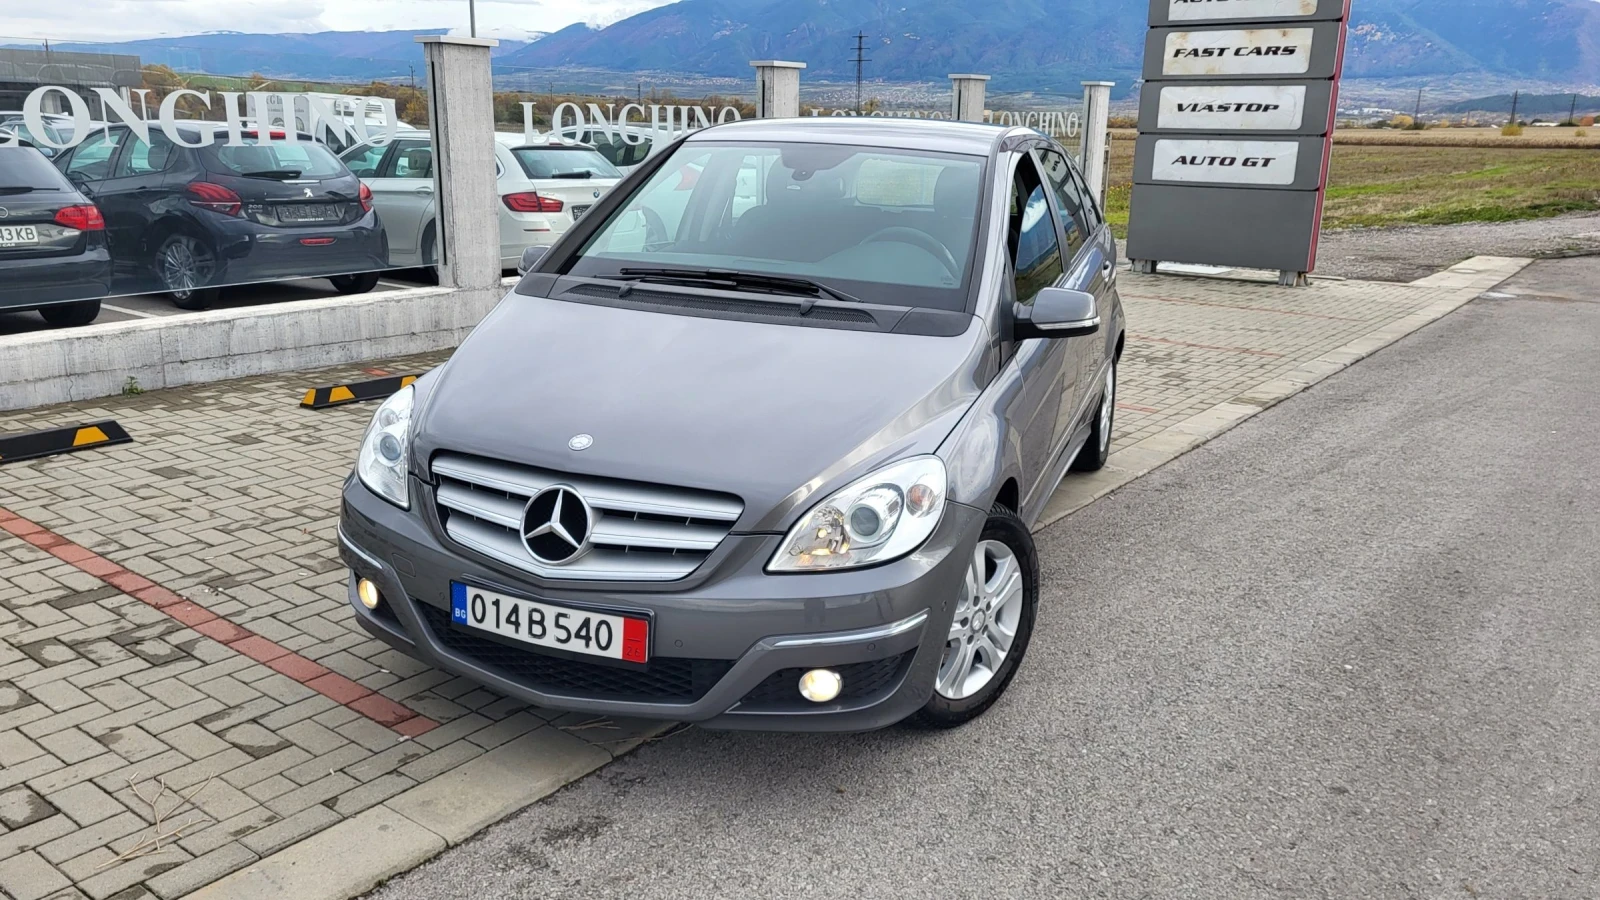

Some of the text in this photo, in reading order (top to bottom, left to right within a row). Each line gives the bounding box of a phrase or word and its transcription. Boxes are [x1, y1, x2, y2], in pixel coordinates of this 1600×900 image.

[1173, 45, 1298, 58] FAST CARS
[1176, 103, 1280, 113] VIASTOP
[1171, 155, 1276, 168] AUTO GT
[455, 607, 467, 619] BG
[626, 646, 641, 657] 26
